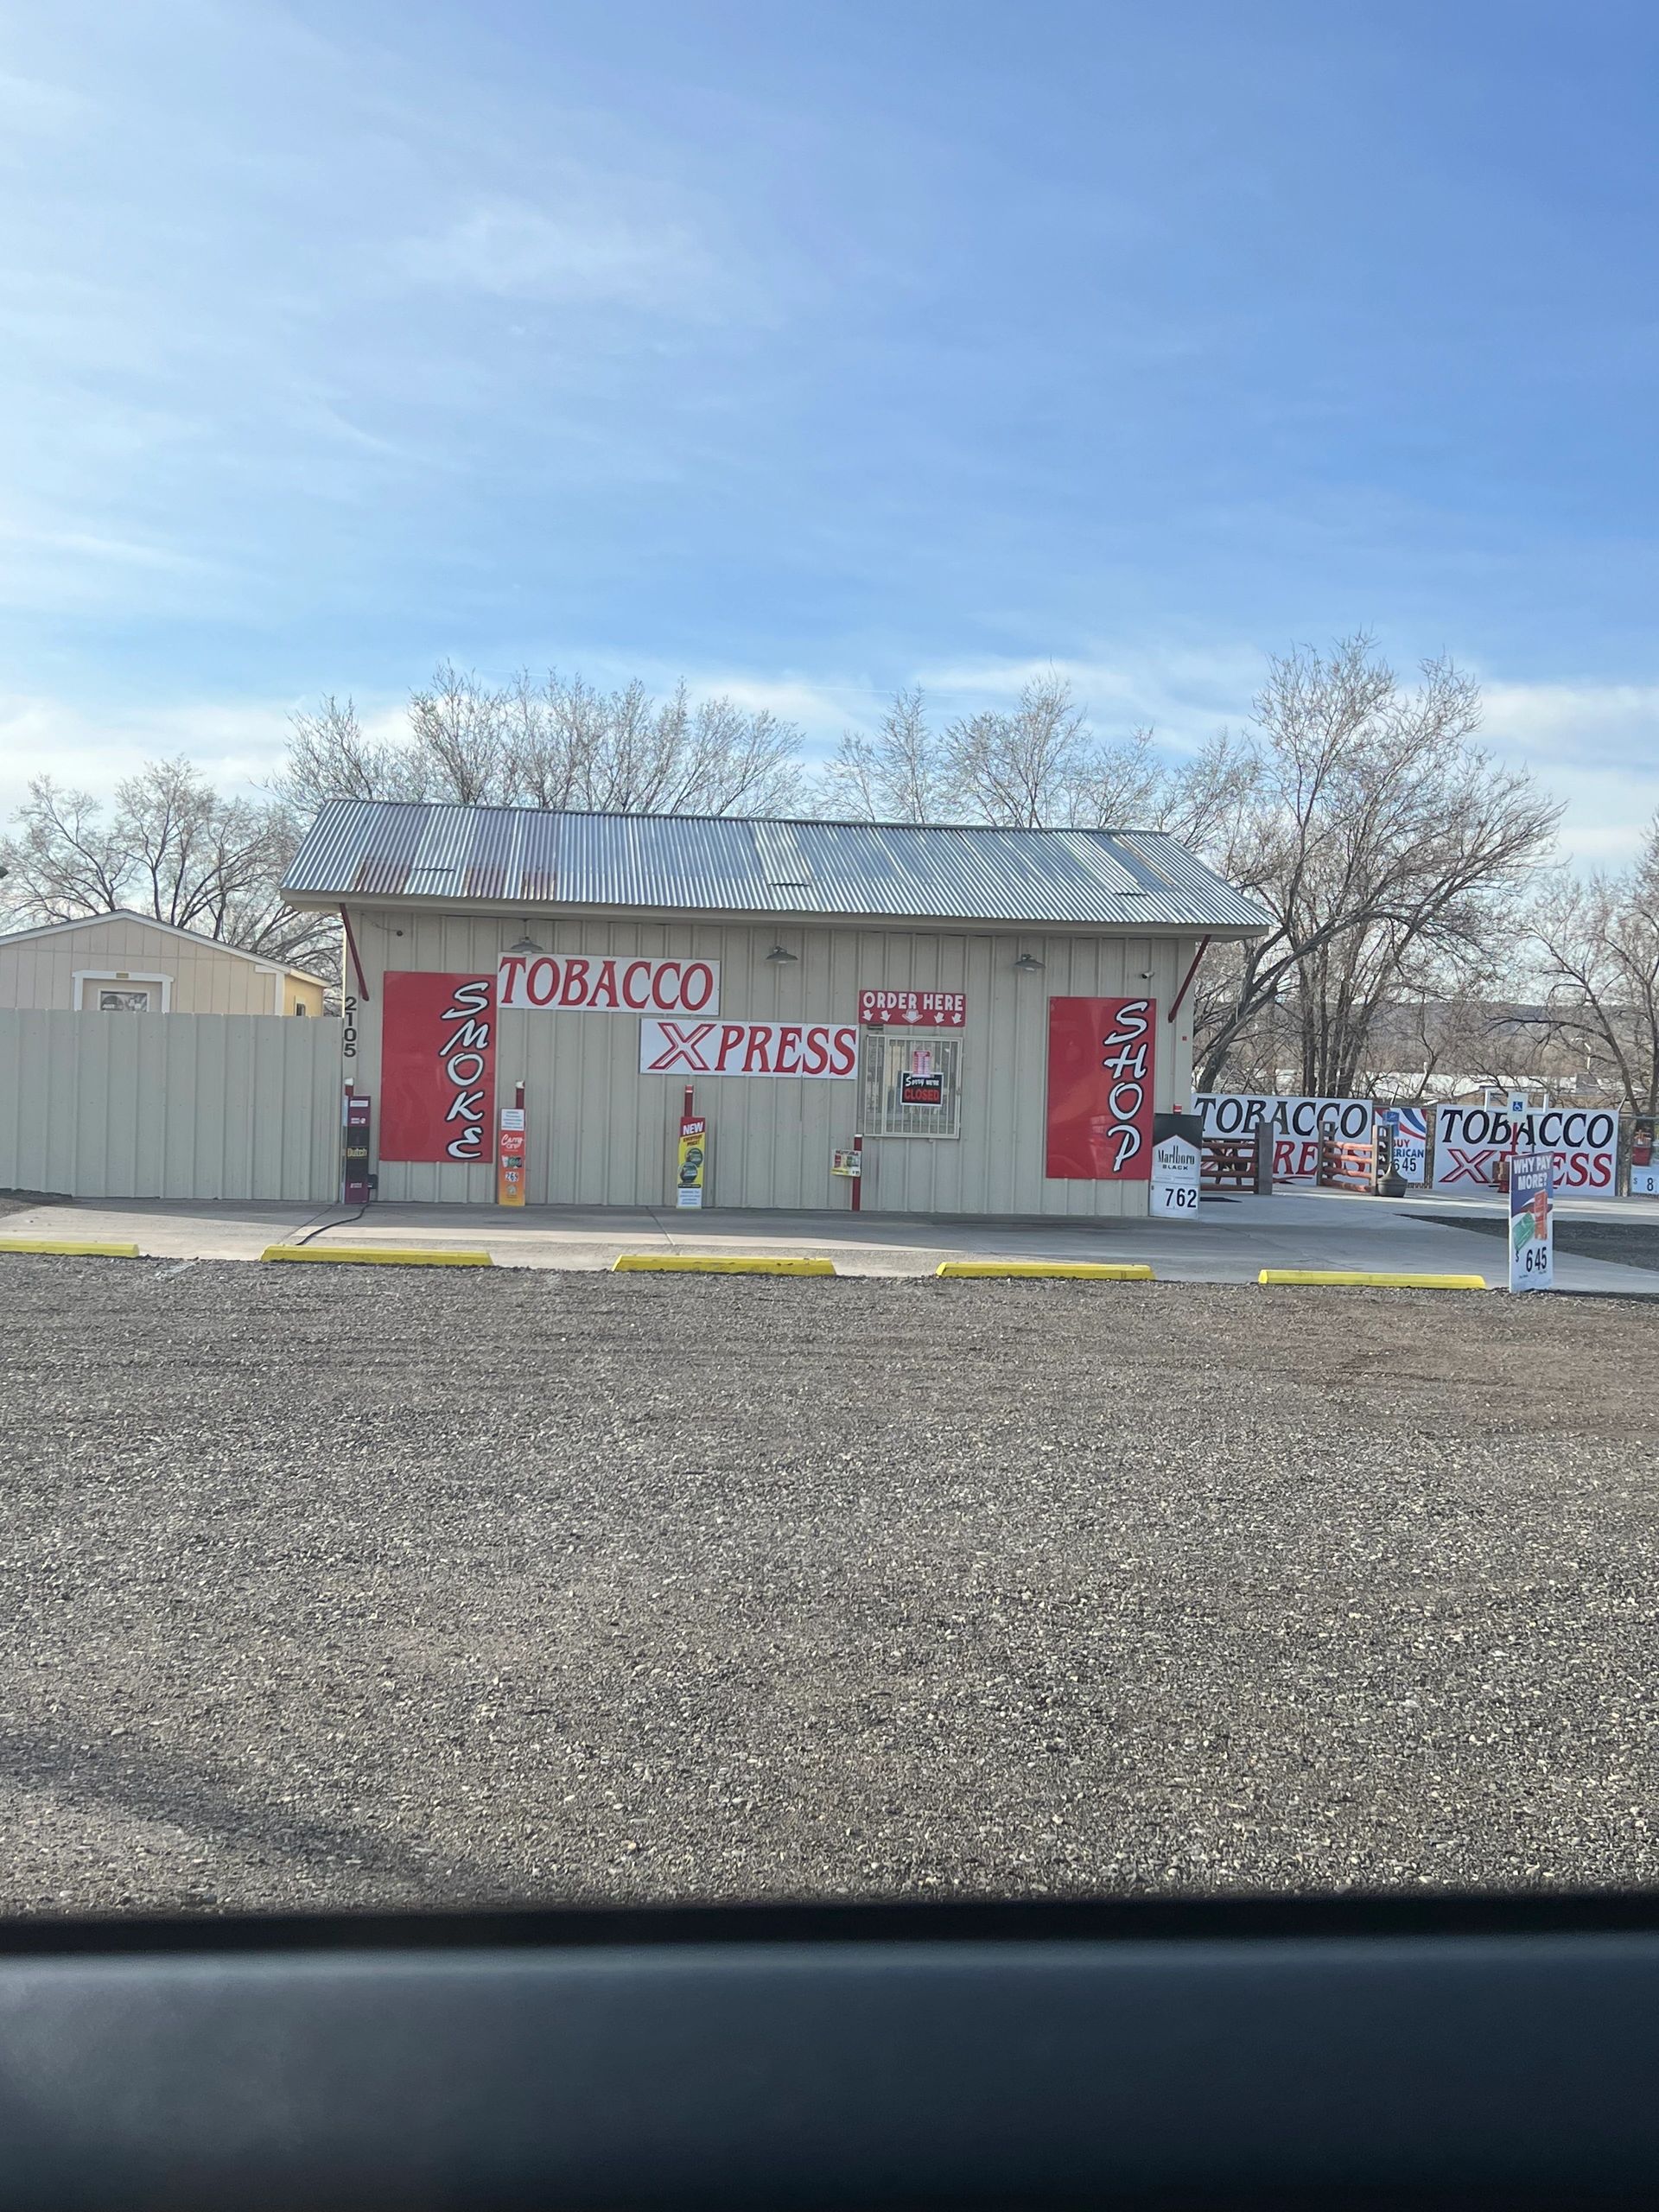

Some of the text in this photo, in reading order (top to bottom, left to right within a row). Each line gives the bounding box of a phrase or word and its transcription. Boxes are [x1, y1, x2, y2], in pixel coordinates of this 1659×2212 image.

[499, 957, 714, 1011] TOBACCO
[863, 991, 963, 1011] ORDER HERE
[344, 996, 357, 1058] 2105
[647, 1021, 857, 1076] XPRESS
[439, 980, 490, 1160] SMOKE
[904, 1088, 940, 1102] CLOSED
[1103, 1001, 1148, 1173] SHOP
[683, 1122, 704, 1135] NEW
[1194, 1097, 1368, 1138] TOBACCO
[1440, 1109, 1614, 1148] TOBACCO
[1158, 1145, 1195, 1165] Marlboro
[1439, 1149, 1612, 1188] XESS
[1513, 1154, 1552, 1174] WHY PAY
[1165, 1187, 1197, 1208] 762
[1517, 1172, 1548, 1191] MORE?
[1526, 1247, 1548, 1272] 645
